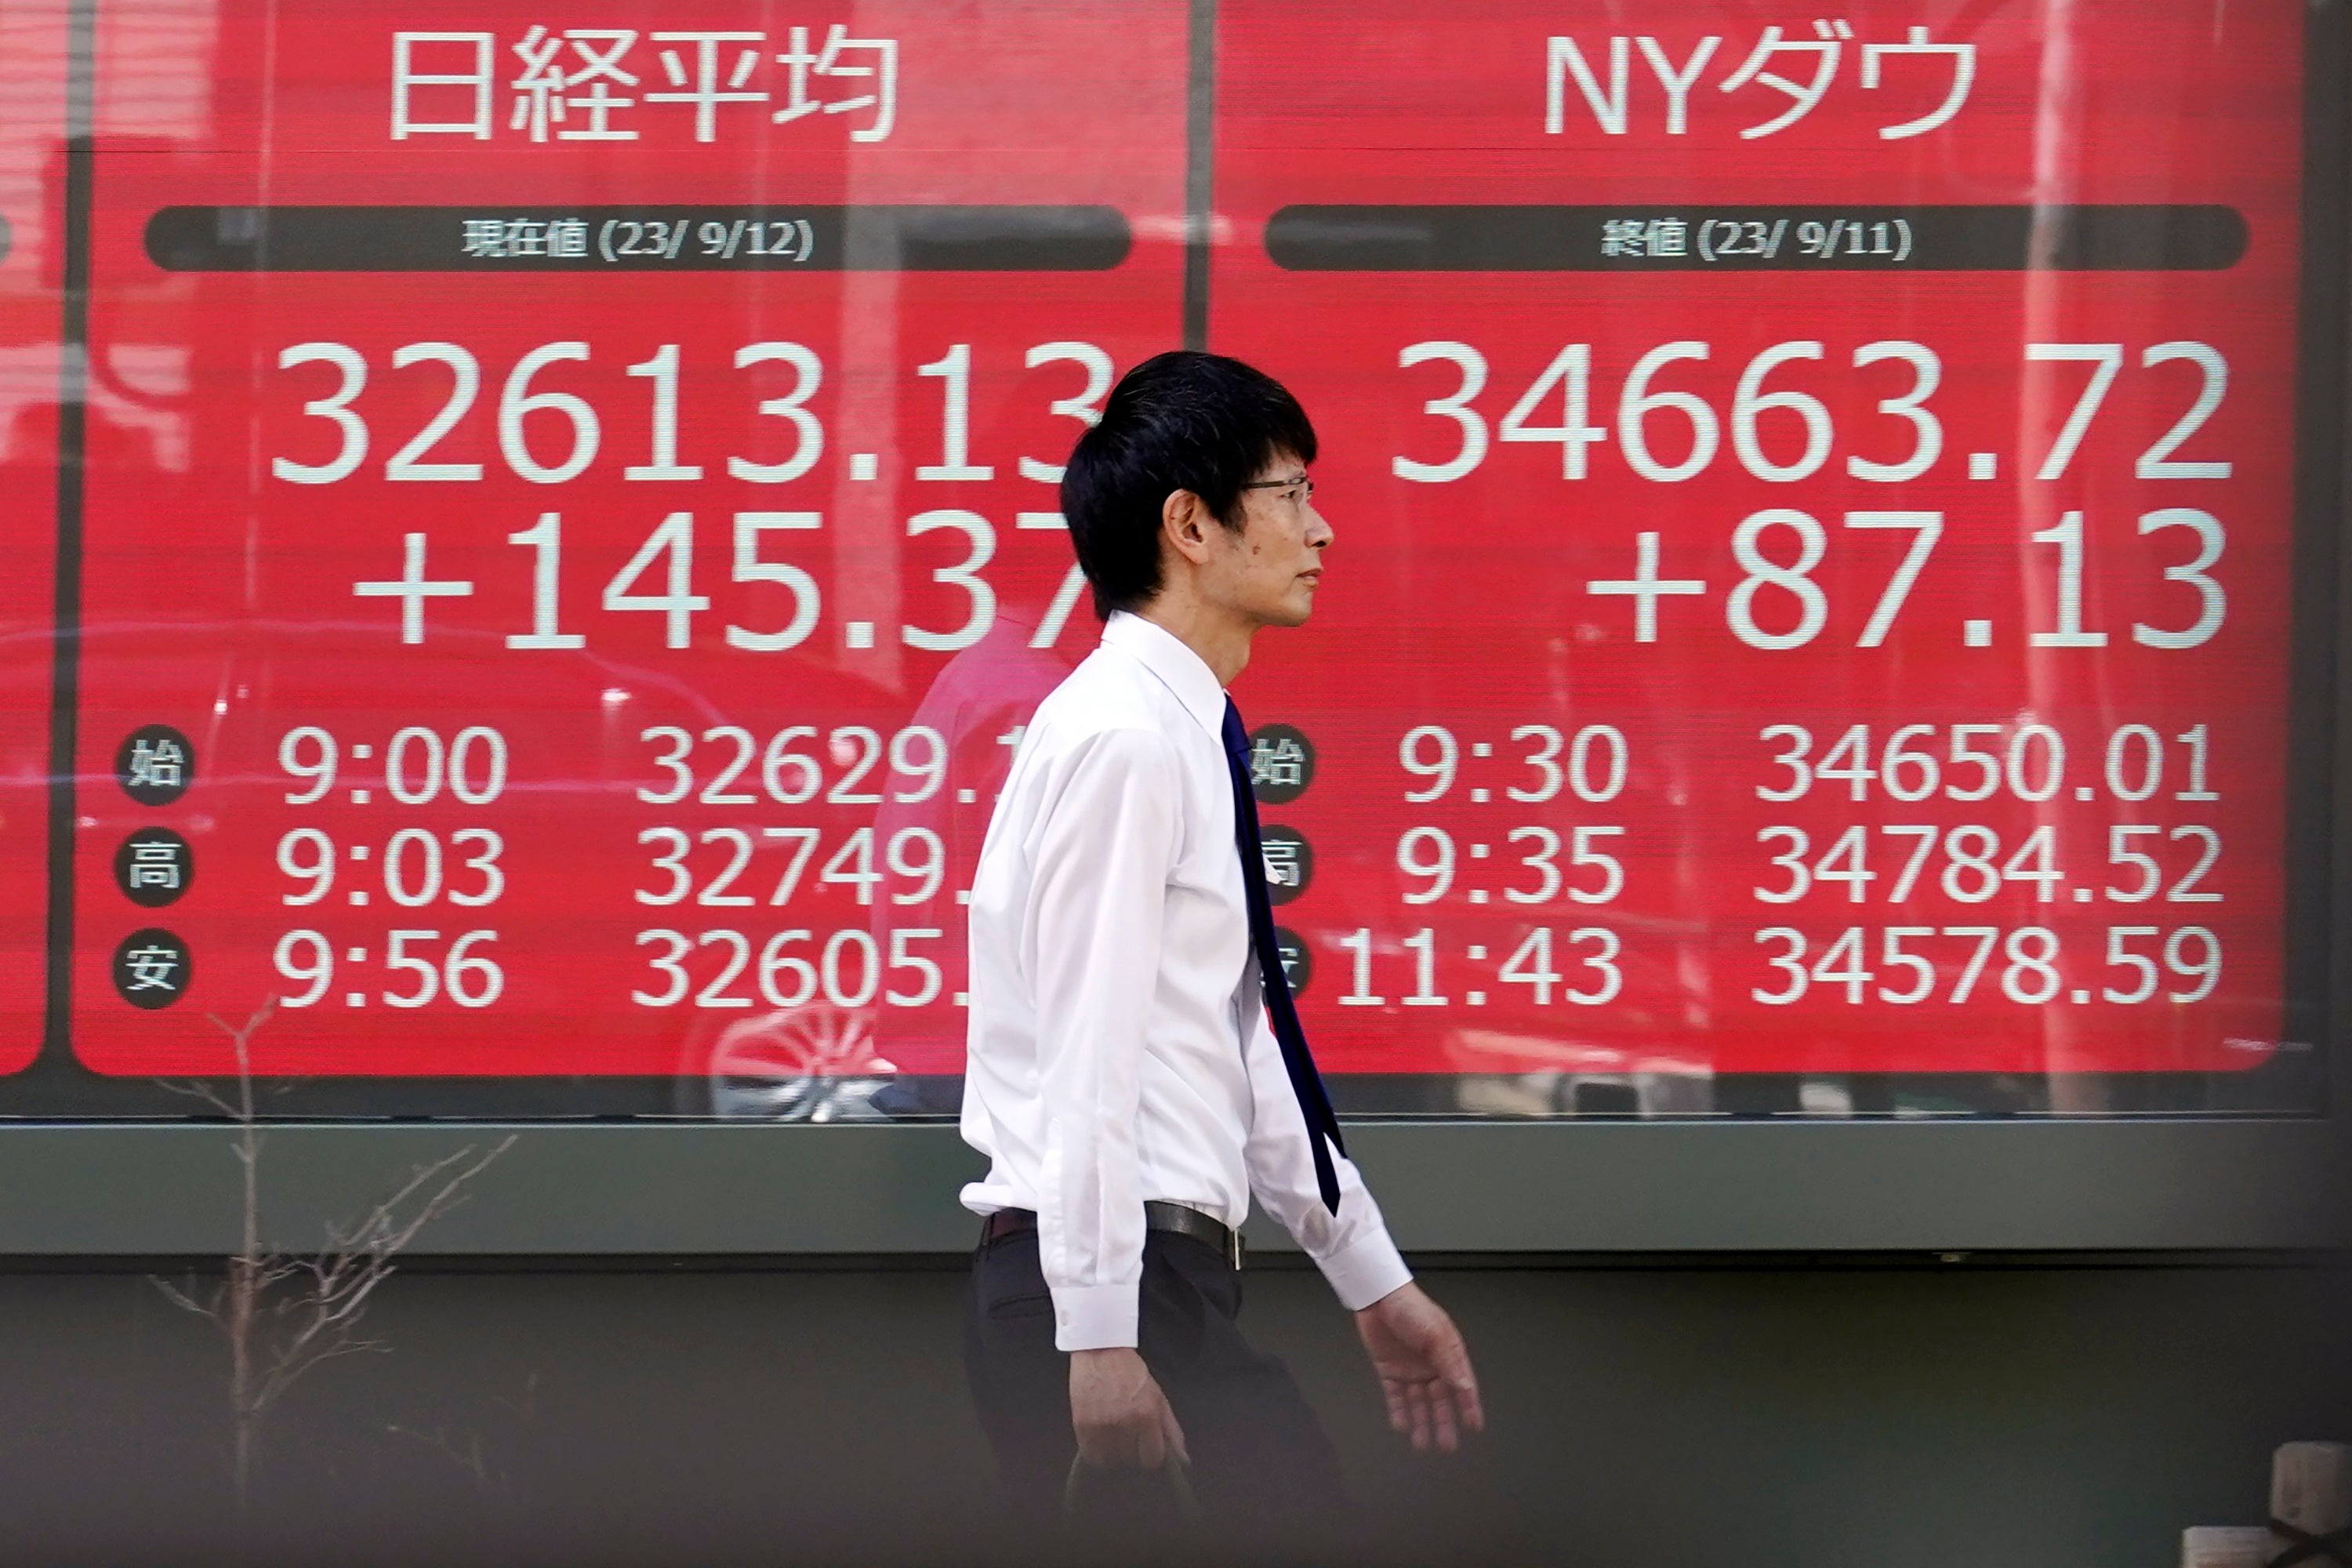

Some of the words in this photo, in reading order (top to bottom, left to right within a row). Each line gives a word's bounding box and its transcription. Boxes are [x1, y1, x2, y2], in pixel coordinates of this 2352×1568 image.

[390, 24, 899, 143] 日経平均
[1544, 19, 1977, 140] NYダウ
[461, 218, 590, 257] 現在値
[598, 220, 690, 262] (23/
[698, 220, 814, 262] 9/12)
[1600, 217, 1689, 256] 終値
[1697, 220, 1789, 261] (23/
[1797, 220, 1912, 261] 9/11)
[273, 341, 1114, 485] 32613.13
[1392, 340, 2231, 483] 34663.72
[1588, 508, 2225, 650] +87.13
[129, 739, 184, 786] 始
[278, 726, 506, 804] 9:00
[637, 725, 1027, 804] 32629.
[1250, 739, 1305, 785] 始
[1400, 724, 1628, 803] 9:30
[1757, 724, 2218, 802] 34650.01
[129, 841, 181, 888] 高
[277, 828, 505, 906] 9:03
[1397, 826, 1624, 904] 9:35
[1755, 825, 2222, 903] 34784.52
[125, 945, 179, 990] 安
[274, 929, 504, 1008] 9:56
[1338, 927, 1623, 1006] 11:43
[1753, 926, 2220, 1004] 34578.59
